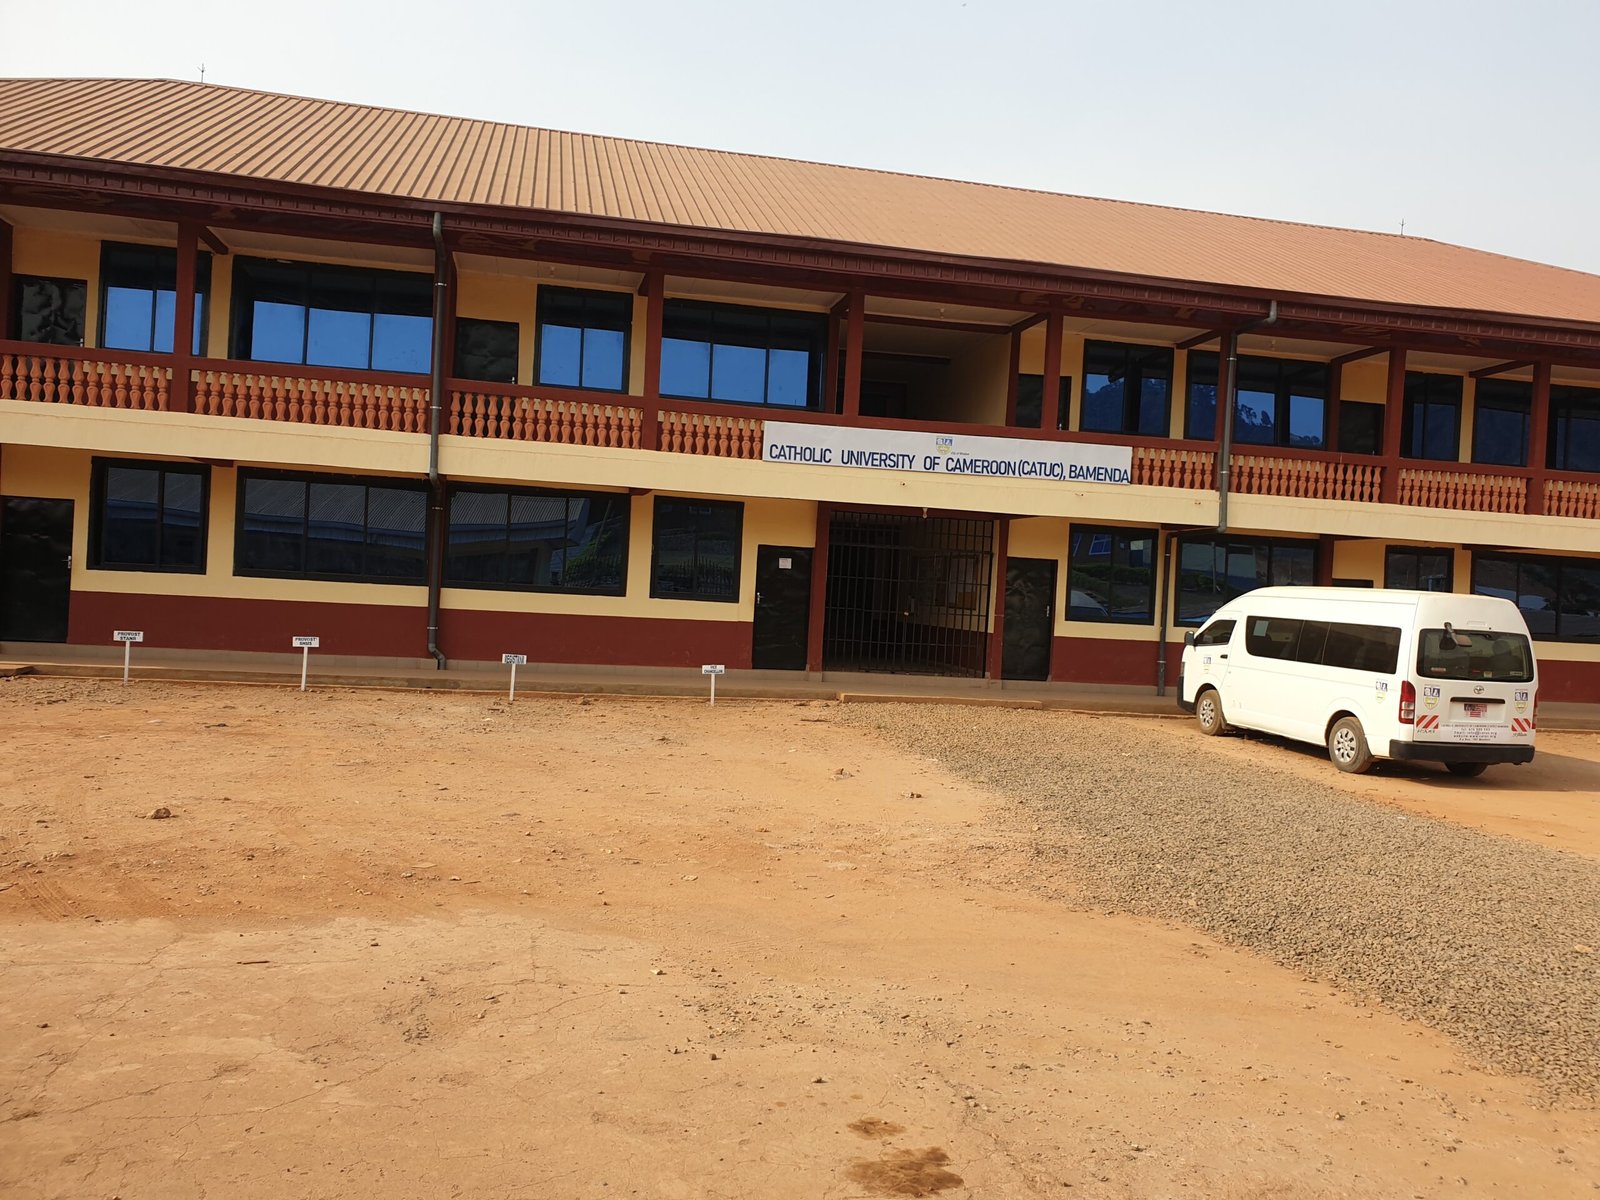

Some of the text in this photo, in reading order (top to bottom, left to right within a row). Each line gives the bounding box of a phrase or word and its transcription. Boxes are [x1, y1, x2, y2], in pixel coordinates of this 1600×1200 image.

[769, 444, 832, 463] CATHOLIC
[841, 449, 916, 470] UNIVERSITY
[923, 455, 941, 471] OF
[945, 457, 1017, 476] CAMEROON
[1069, 464, 1130, 483] BAMENDA
